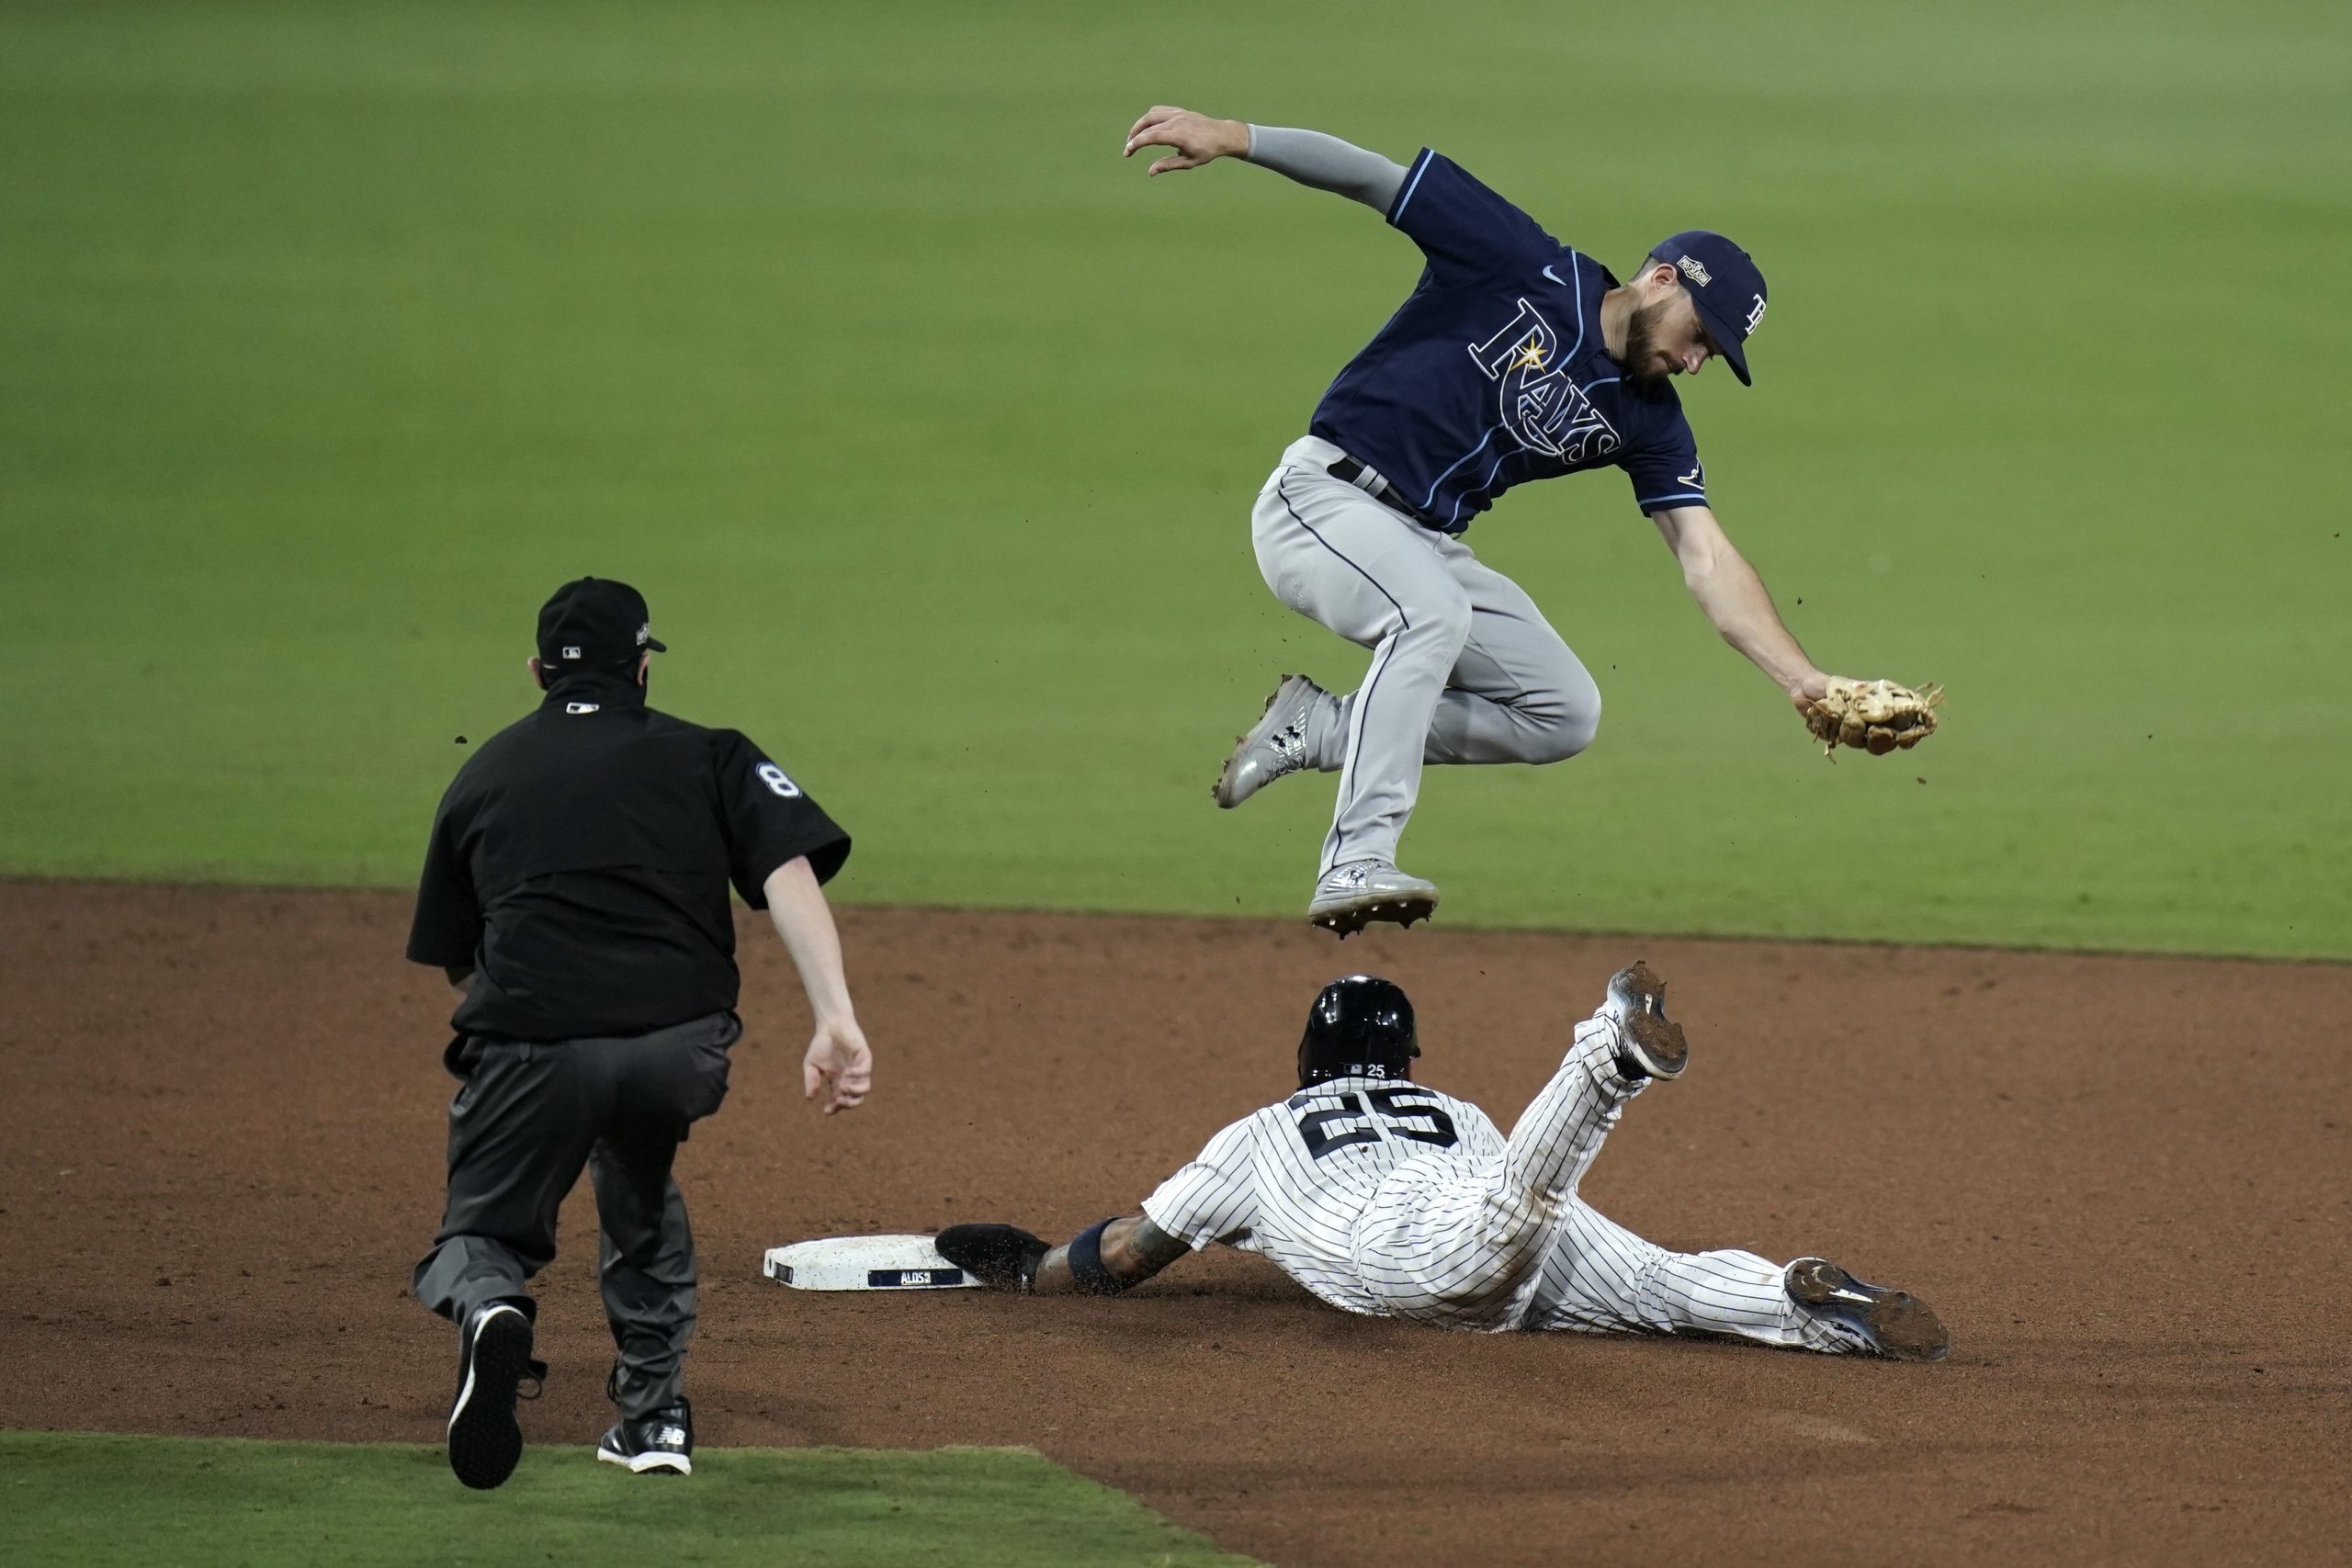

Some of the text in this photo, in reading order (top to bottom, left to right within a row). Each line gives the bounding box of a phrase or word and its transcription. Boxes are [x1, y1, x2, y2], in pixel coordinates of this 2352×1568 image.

[755, 761, 803, 799] 8
[1367, 1064, 1385, 1077] 25
[1288, 1088, 1460, 1161] 25
[901, 1271, 924, 1284] ALDS
